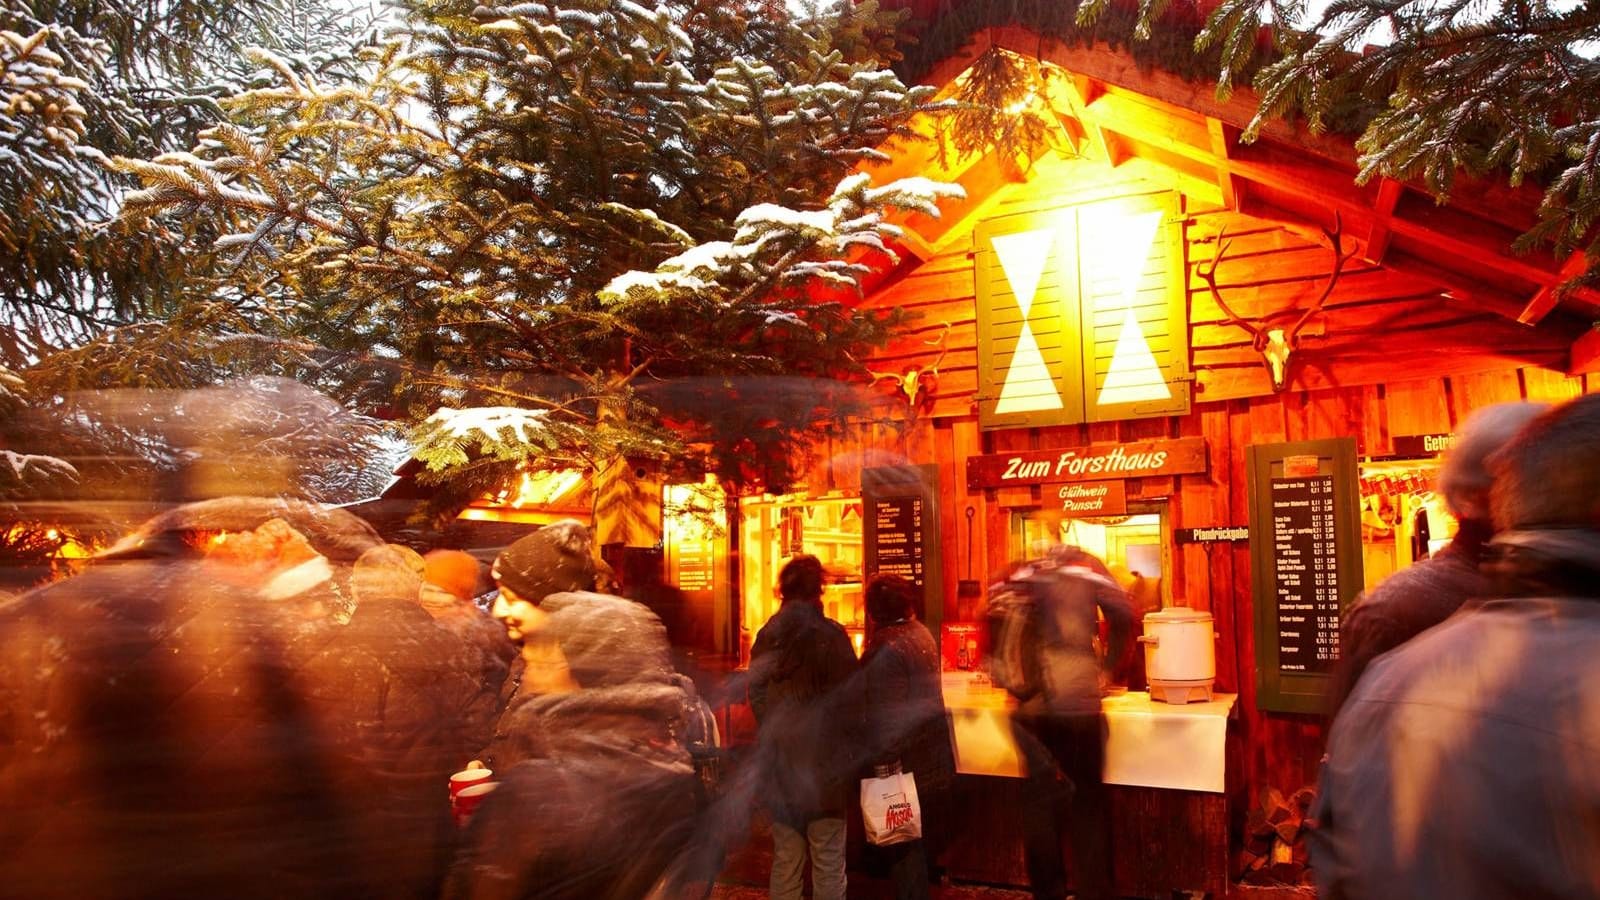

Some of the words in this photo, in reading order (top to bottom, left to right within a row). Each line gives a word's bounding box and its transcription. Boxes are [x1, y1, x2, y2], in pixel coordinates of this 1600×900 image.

[1001, 457, 1051, 480] Zum
[1055, 447, 1167, 476] Forsthaus
[1058, 485, 1107, 499] Glühwein
[1063, 499, 1103, 511] Punsch
[1193, 526, 1249, 543] Pfandrückgabe
